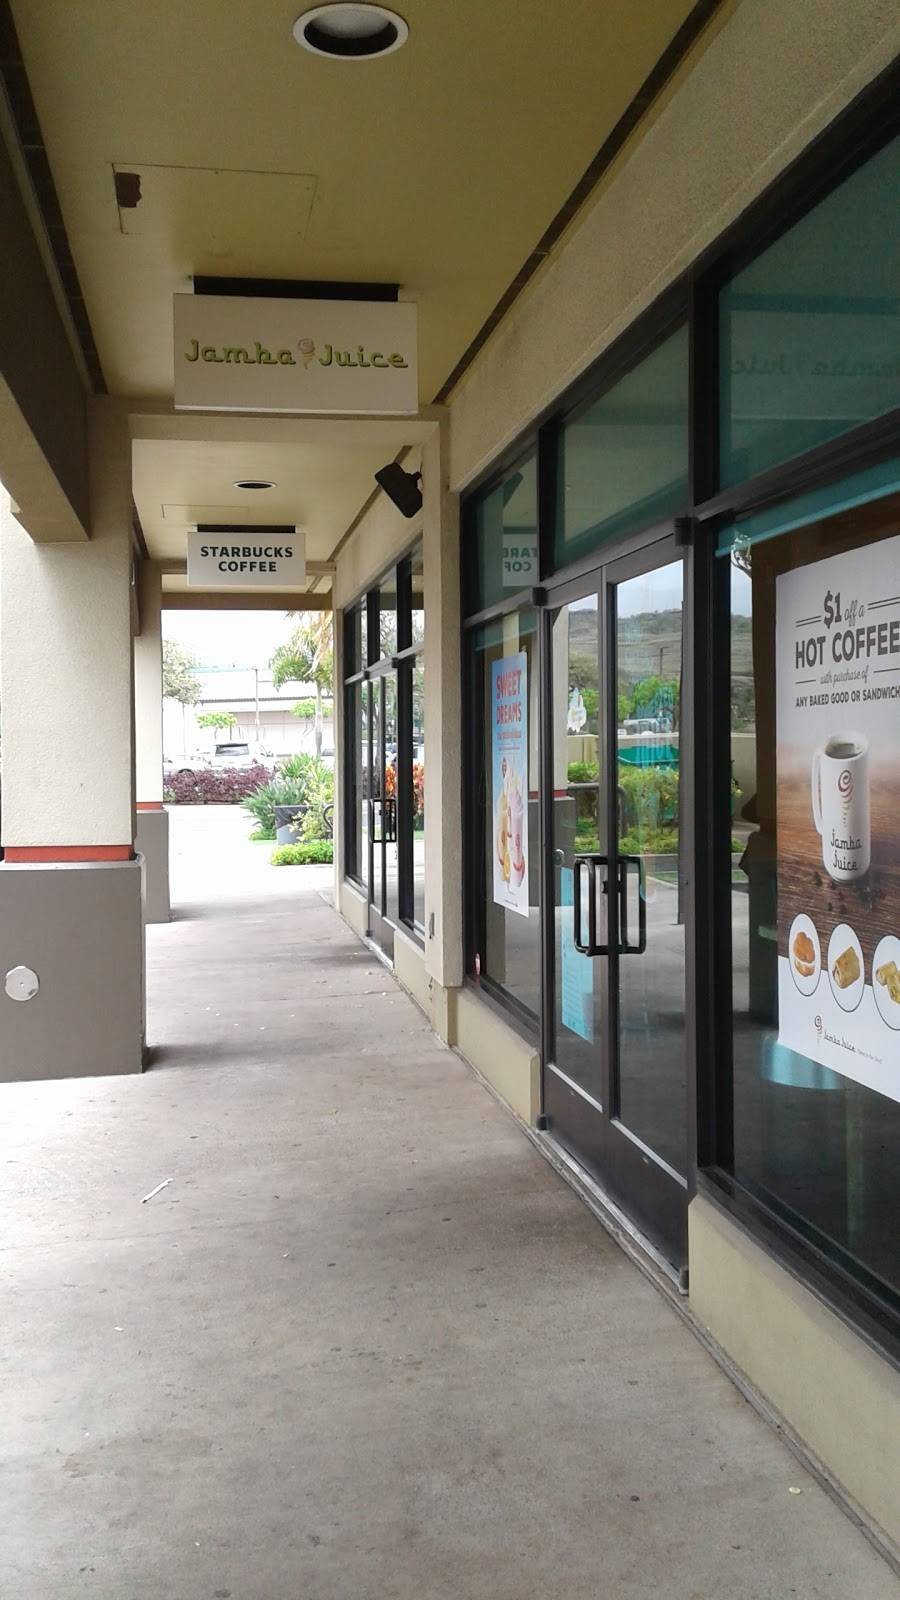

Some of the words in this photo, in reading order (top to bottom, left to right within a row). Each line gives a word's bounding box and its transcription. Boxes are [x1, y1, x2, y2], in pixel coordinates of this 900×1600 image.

[184, 338, 296, 365] Jamba
[318, 344, 408, 368] Juice
[200, 546, 294, 559] STARBUCKS
[218, 560, 277, 573] COFFEE
[823, 590, 842, 629] $1
[844, 600, 858, 627] off
[858, 604, 865, 618] a
[795, 635, 826, 669] HOT
[832, 620, 900, 663] COFFEE
[496, 669, 522, 700] SWEET
[820, 671, 832, 685] with
[833, 667, 861, 688] purchase
[862, 664, 869, 684] of
[795, 696, 808, 708] ANY
[809, 693, 830, 707] BAKED
[831, 691, 849, 705] GOOD
[851, 690, 861, 703] OR
[862, 686, 900, 702] SANDWICH
[496, 703, 522, 725] DREAMS
